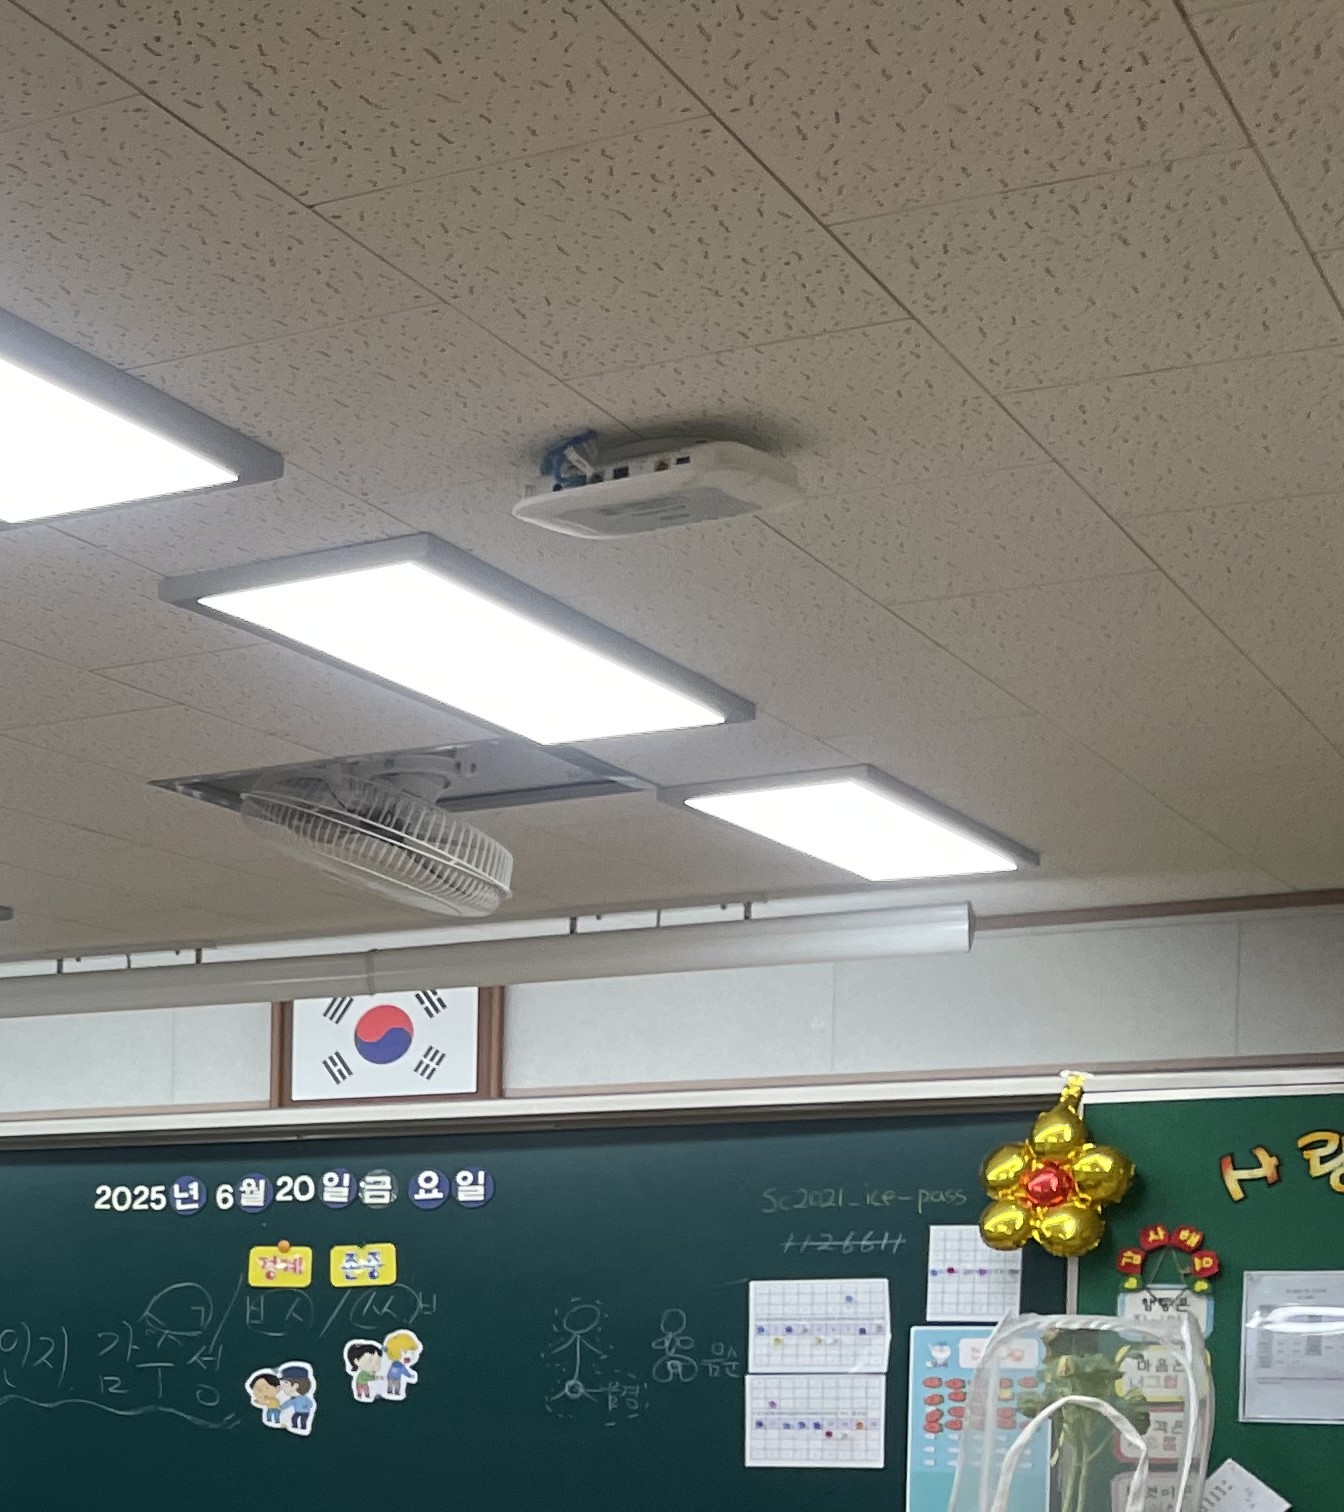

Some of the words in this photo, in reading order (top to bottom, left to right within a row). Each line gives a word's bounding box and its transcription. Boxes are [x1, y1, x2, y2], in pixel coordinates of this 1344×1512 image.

[94, 1180, 202, 1212] 2025년
[215, 1177, 267, 1210] 6월
[275, 1170, 352, 1204] 20일
